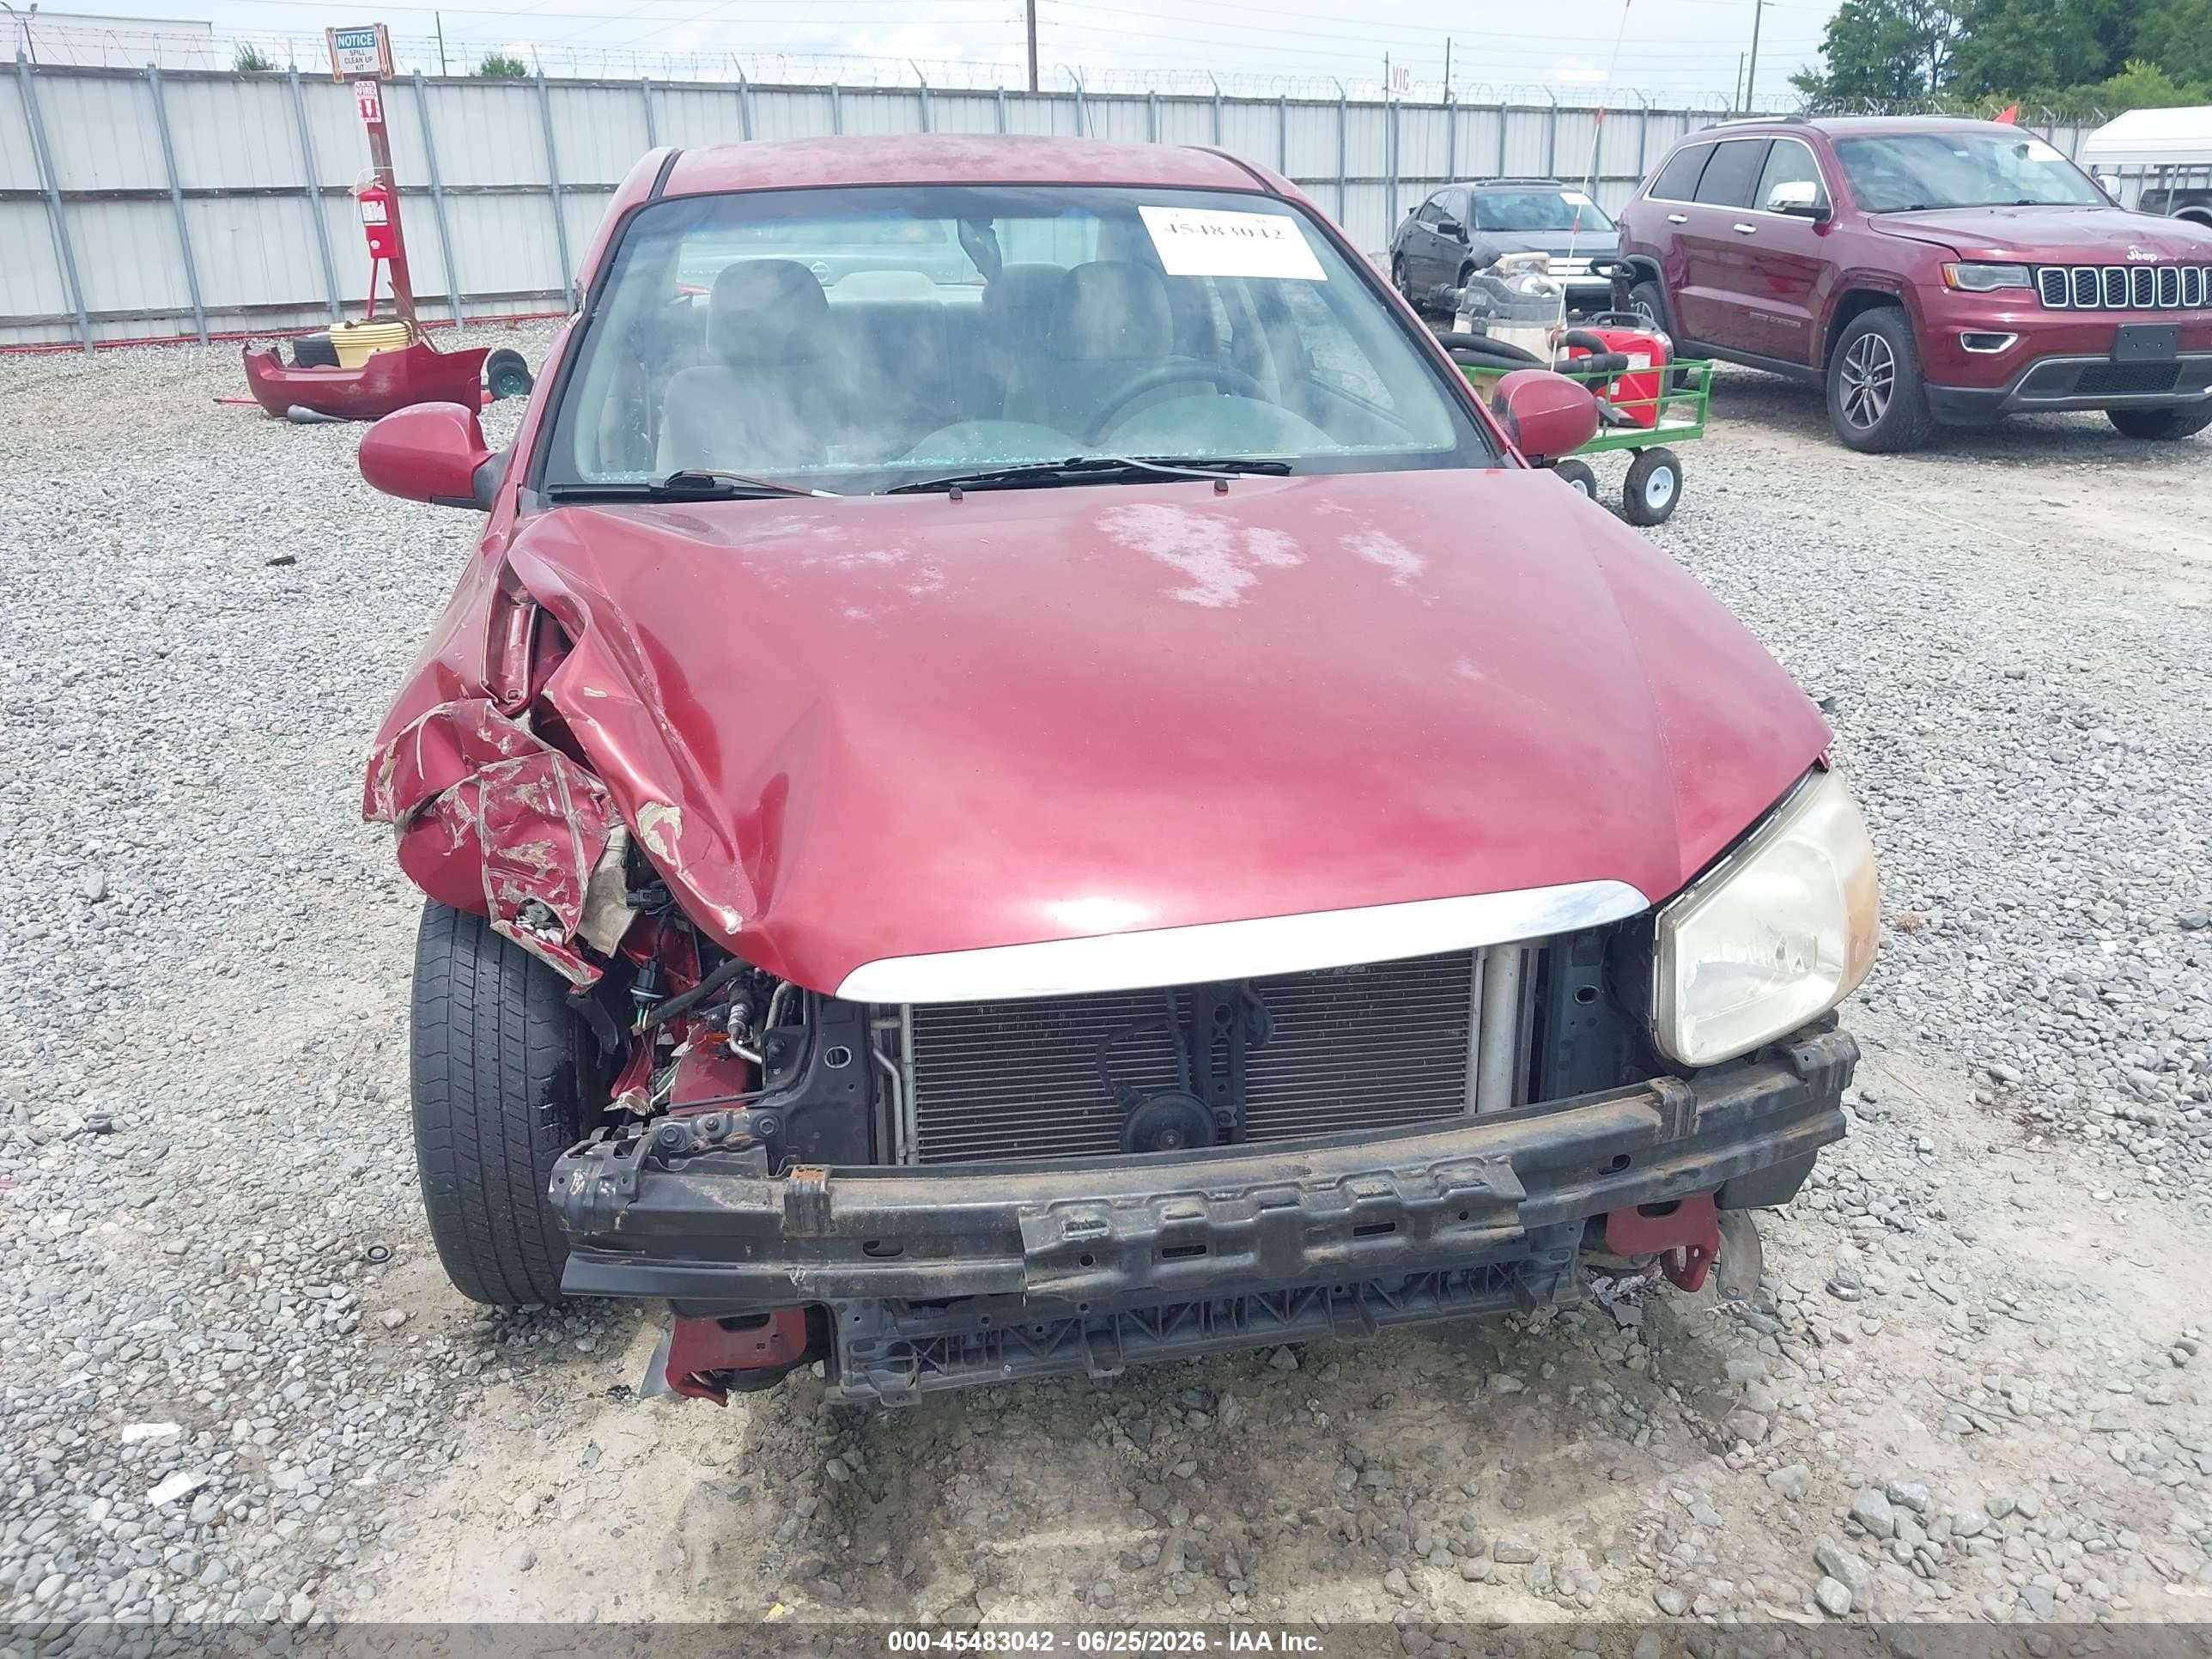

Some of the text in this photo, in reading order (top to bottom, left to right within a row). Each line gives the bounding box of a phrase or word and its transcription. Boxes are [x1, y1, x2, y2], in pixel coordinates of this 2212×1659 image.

[337, 33, 373, 47] NOTICE
[359, 86, 374, 95] FIRE
[2126, 250, 2158, 263] Jeep
